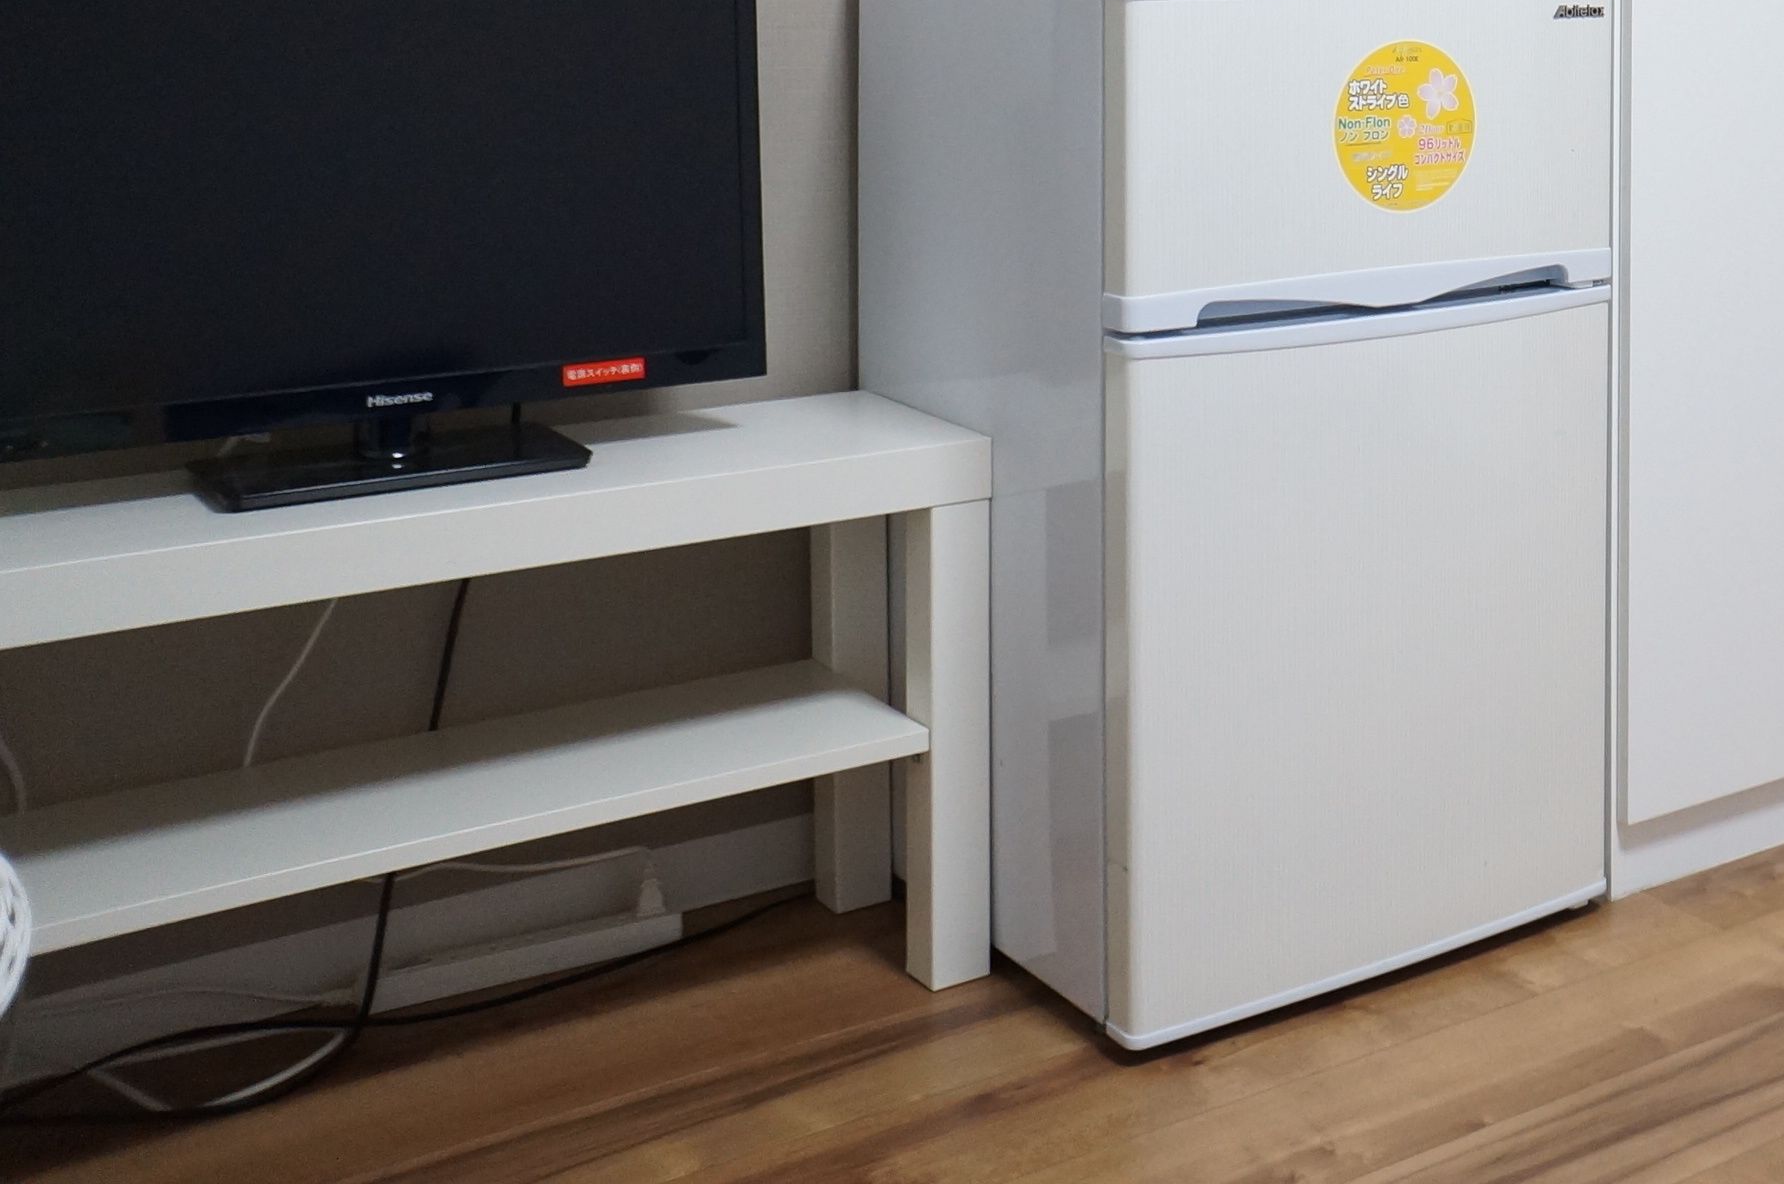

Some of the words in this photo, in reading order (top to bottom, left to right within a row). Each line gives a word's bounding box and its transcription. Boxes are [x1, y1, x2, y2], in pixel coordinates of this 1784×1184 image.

[1348, 79, 1388, 95] ホワイト
[1348, 94, 1410, 111] ストライプ色
[1366, 163, 1409, 183] シングル
[1371, 183, 1404, 201] ライフ
[366, 391, 433, 408] Hisense
